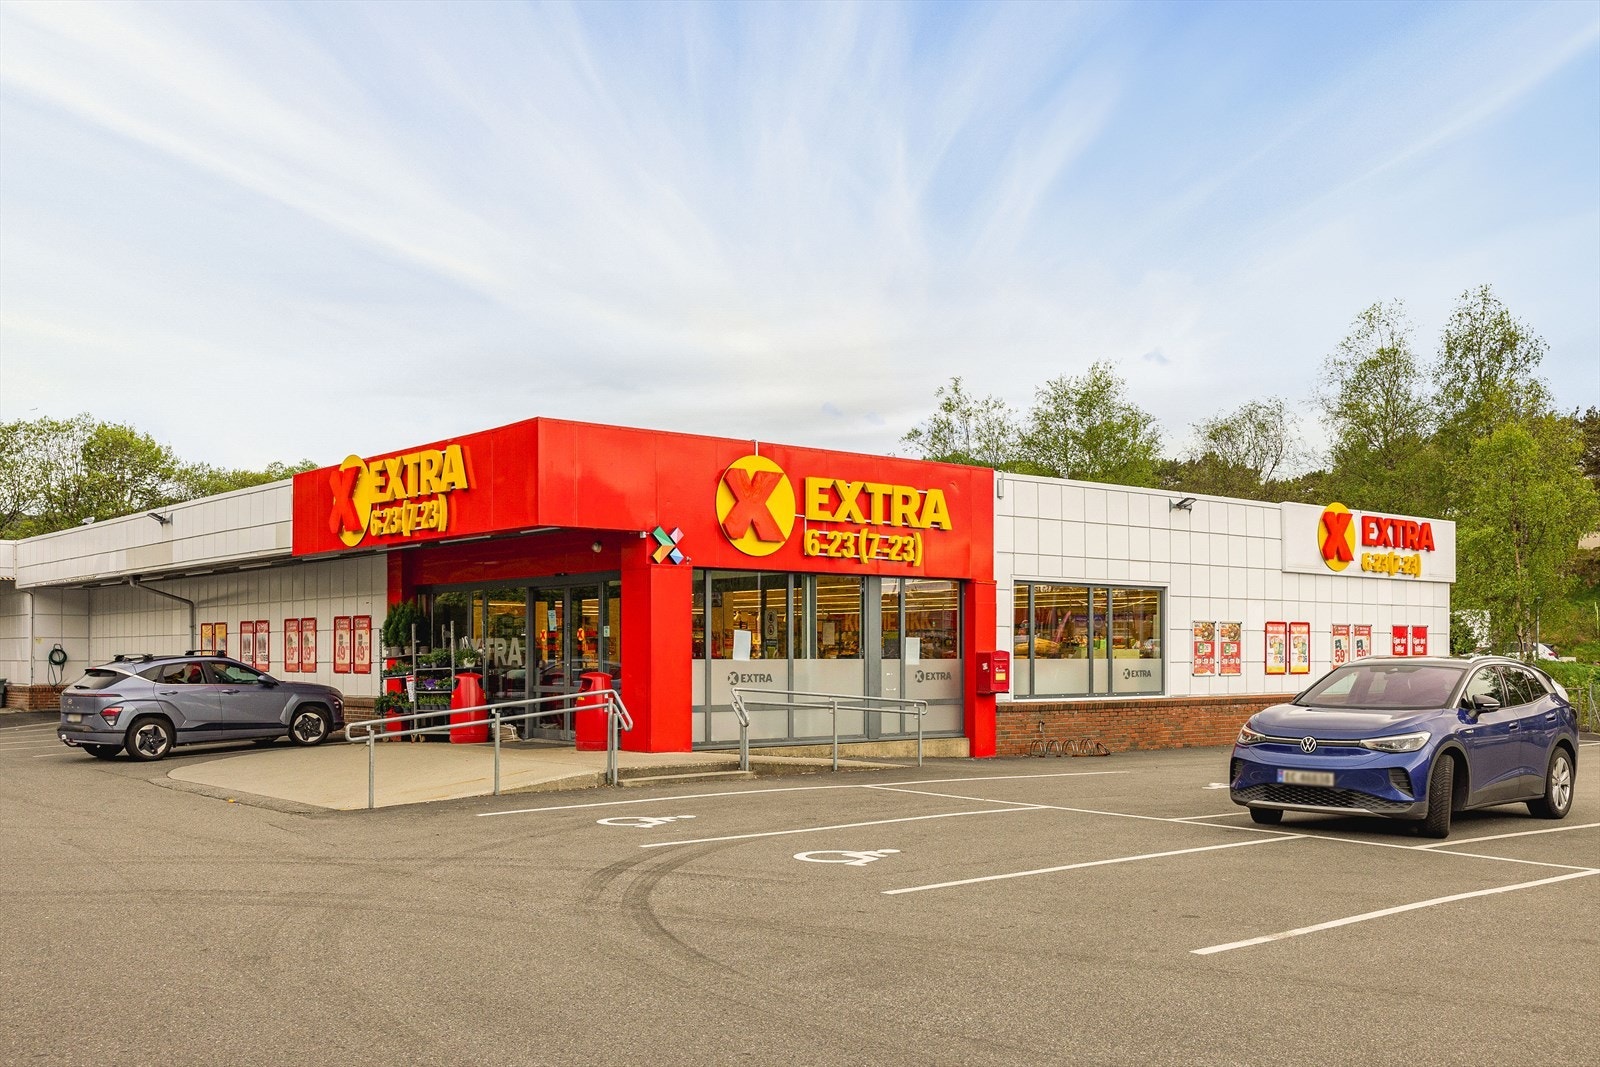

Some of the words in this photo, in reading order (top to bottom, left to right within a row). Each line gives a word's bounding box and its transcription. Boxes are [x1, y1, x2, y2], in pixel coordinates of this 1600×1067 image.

[370, 445, 468, 505] EXTRA
[804, 476, 953, 530] EXTRA
[1361, 515, 1435, 552] EXTRA
[1335, 649, 1345, 663] 59
[740, 673, 773, 683] EXTRA
[925, 671, 952, 681] EXTRA
[1131, 669, 1152, 678] EXTRA
